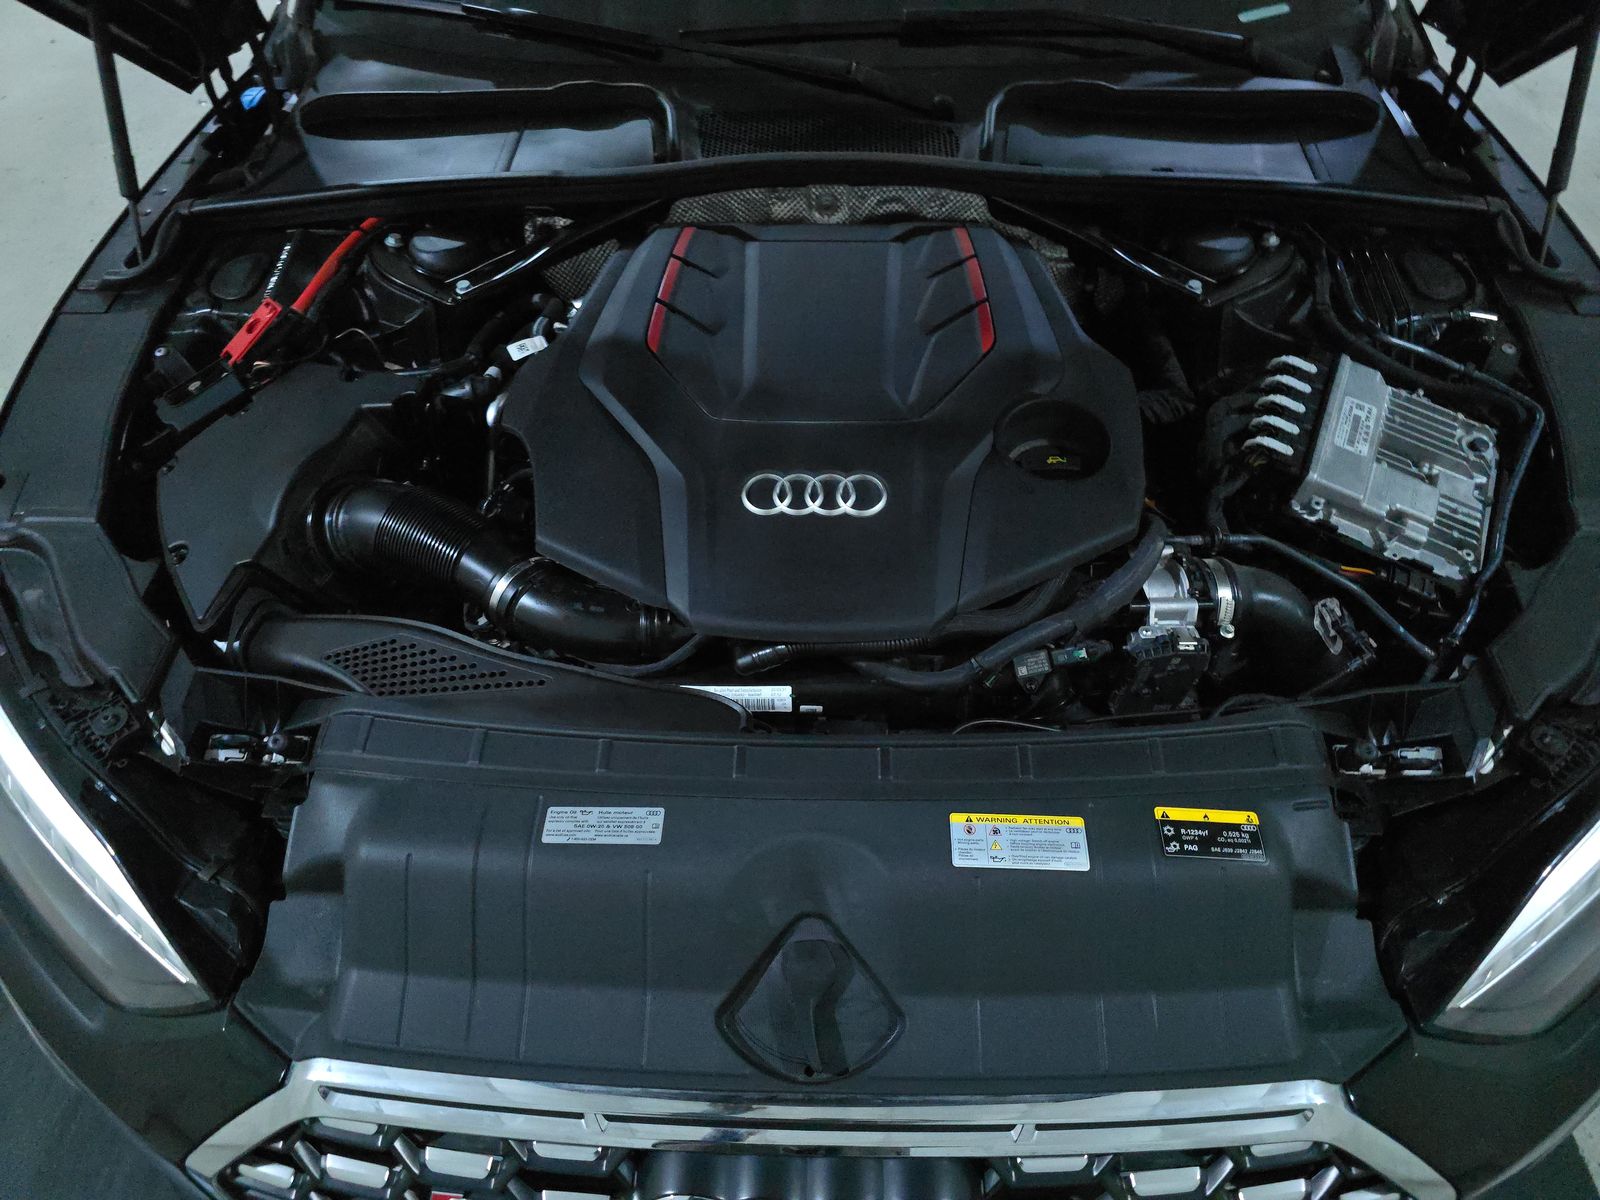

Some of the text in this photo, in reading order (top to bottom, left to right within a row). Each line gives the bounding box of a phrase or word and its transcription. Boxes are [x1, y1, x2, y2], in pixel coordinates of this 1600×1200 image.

[975, 816, 1018, 824] WARNING
[1180, 828, 1209, 837] R-1234yf
[1241, 831, 1250, 839] kg
